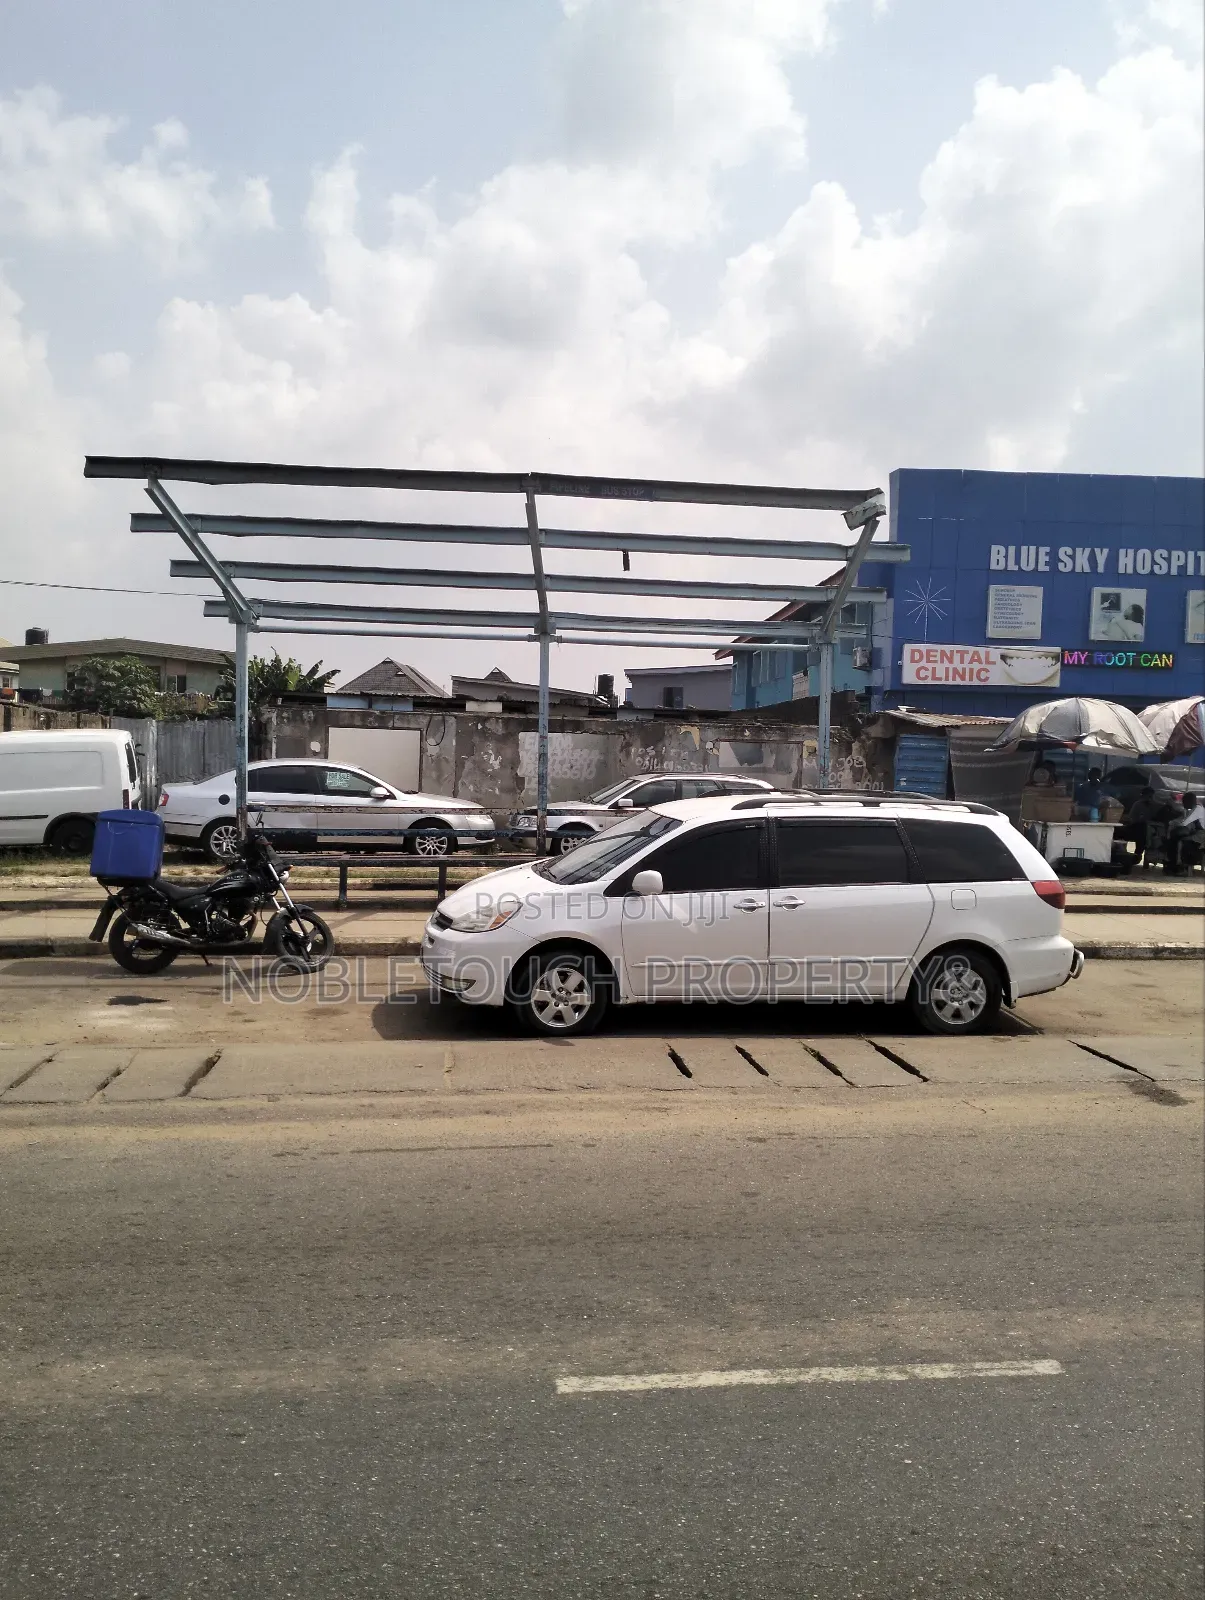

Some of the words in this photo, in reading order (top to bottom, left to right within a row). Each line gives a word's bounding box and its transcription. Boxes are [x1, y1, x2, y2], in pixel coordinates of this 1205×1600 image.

[601, 484, 620, 495] BUS
[620, 486, 644, 497] STOP
[989, 545, 1050, 572] BLUE
[1058, 546, 1109, 573] SKY
[910, 648, 996, 665] DENTAL
[1093, 652, 1136, 666] ROOT
[1140, 653, 1173, 668] CAN
[915, 665, 990, 682] CLINIC
